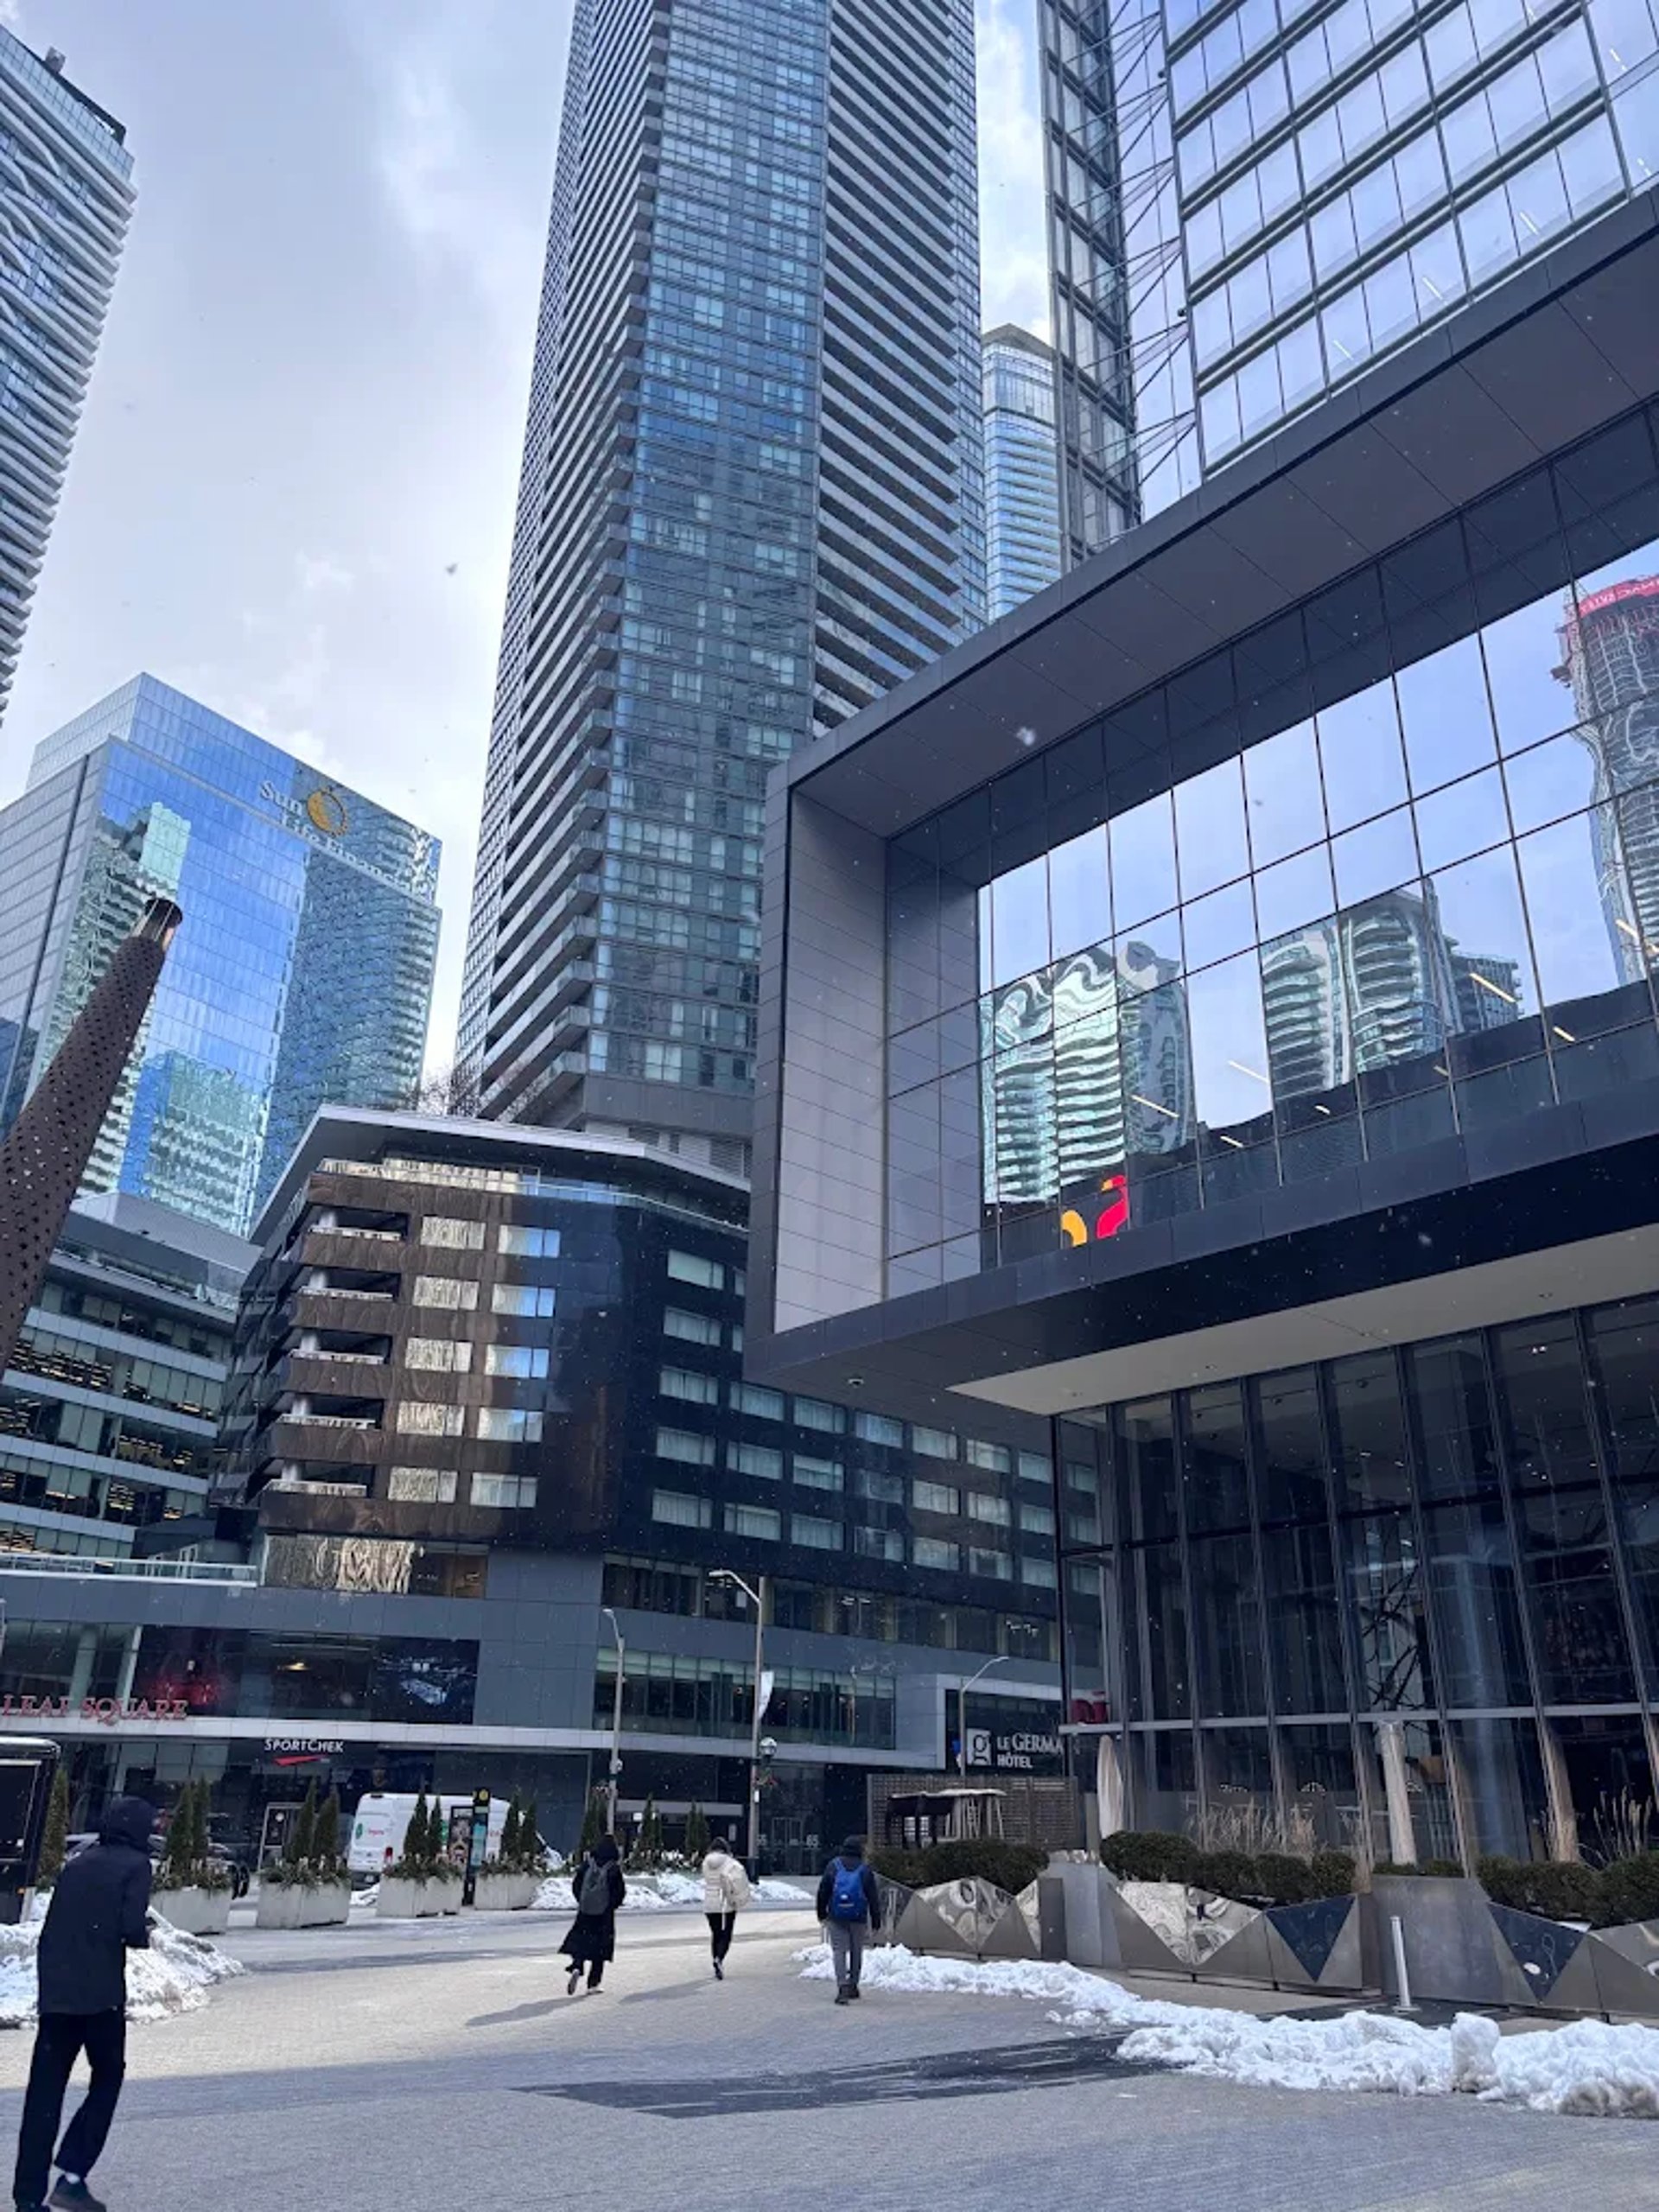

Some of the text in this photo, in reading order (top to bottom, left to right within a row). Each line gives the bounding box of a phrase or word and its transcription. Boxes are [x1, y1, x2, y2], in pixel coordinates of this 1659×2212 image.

[260, 780, 303, 816] Sun
[280, 812, 321, 843] Life
[1, 1694, 189, 1726] LEAF SQUARE
[264, 1738, 344, 1753] SPORTCHEK
[996, 1736, 1010, 1750] LE
[996, 1753, 1033, 1769] HÔTEL
